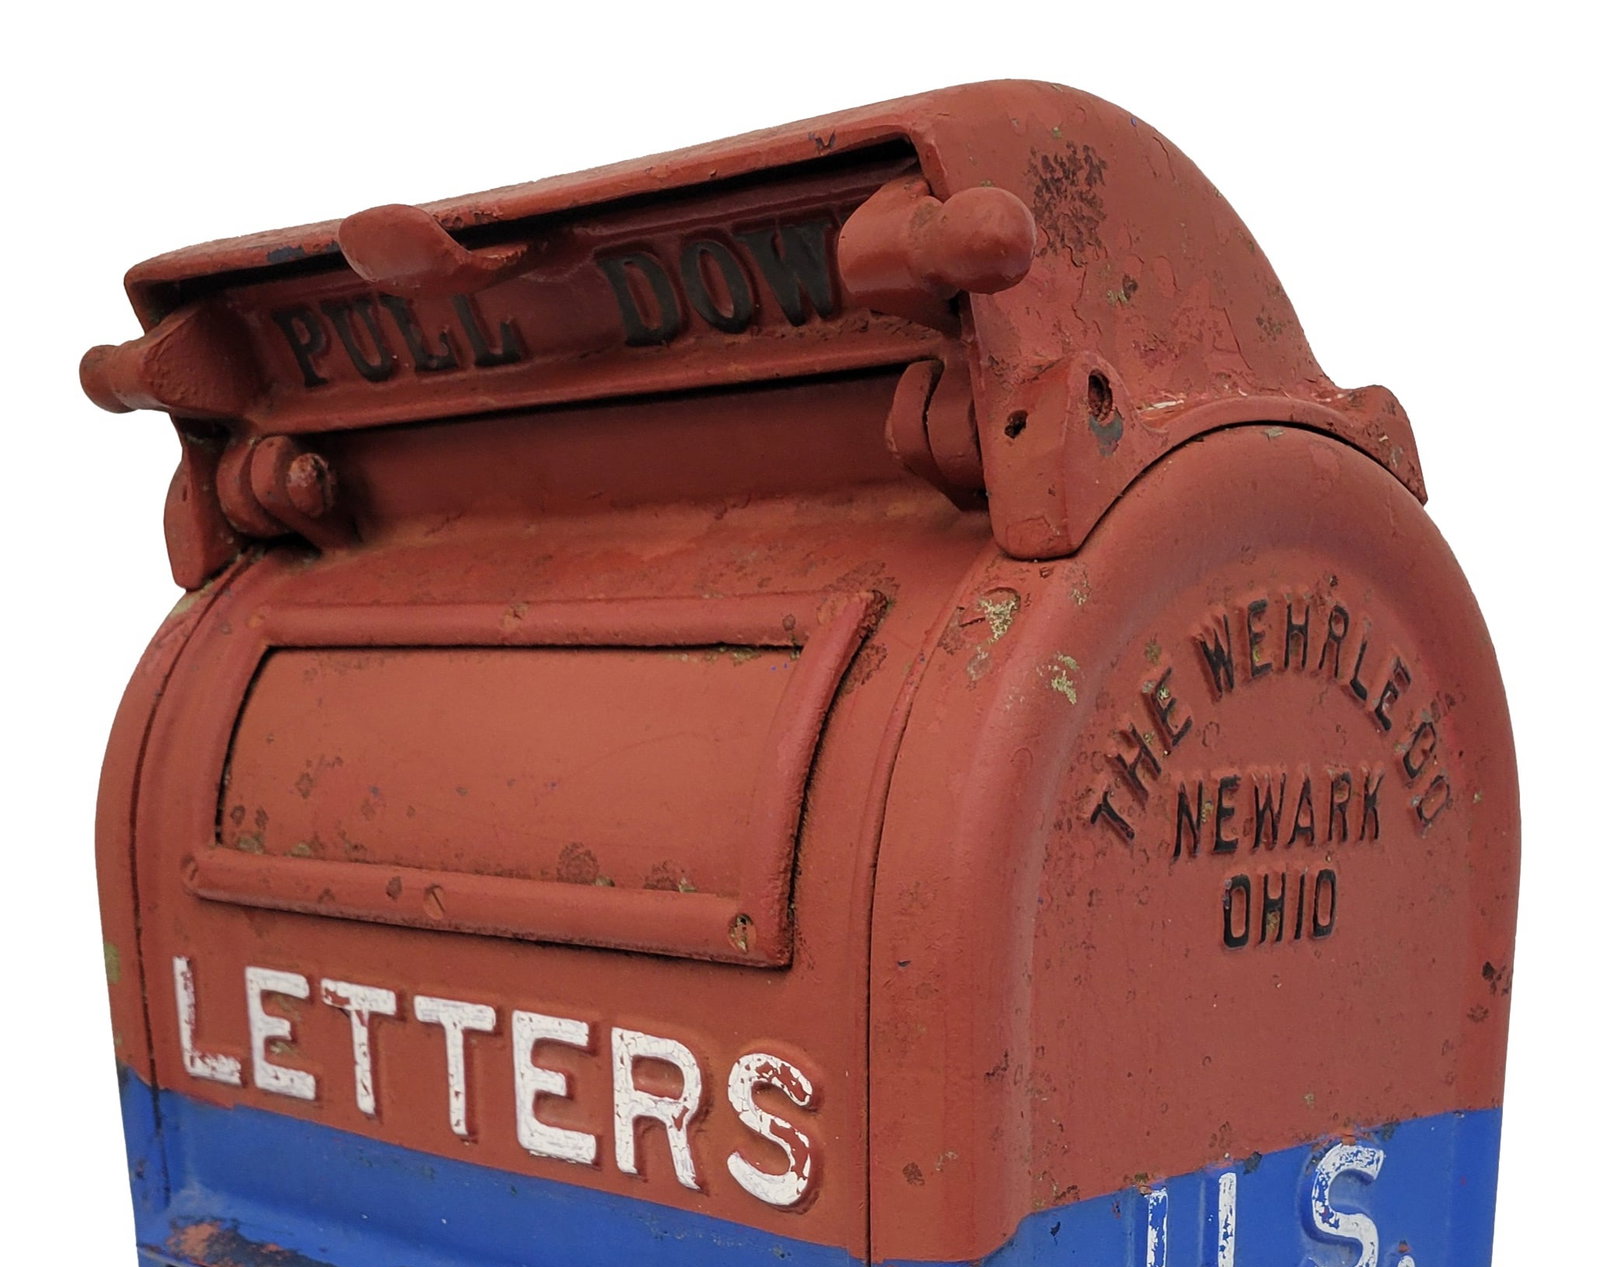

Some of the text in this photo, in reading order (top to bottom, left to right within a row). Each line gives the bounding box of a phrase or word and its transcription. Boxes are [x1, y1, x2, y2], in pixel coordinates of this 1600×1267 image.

[271, 217, 848, 388] PULL DOW
[1090, 667, 1193, 842] THE
[1197, 597, 1412, 732] WEHRLE
[1171, 770, 1384, 862] NEWARK
[1223, 868, 1338, 949] OHIO
[172, 955, 814, 1207] LETTERS
